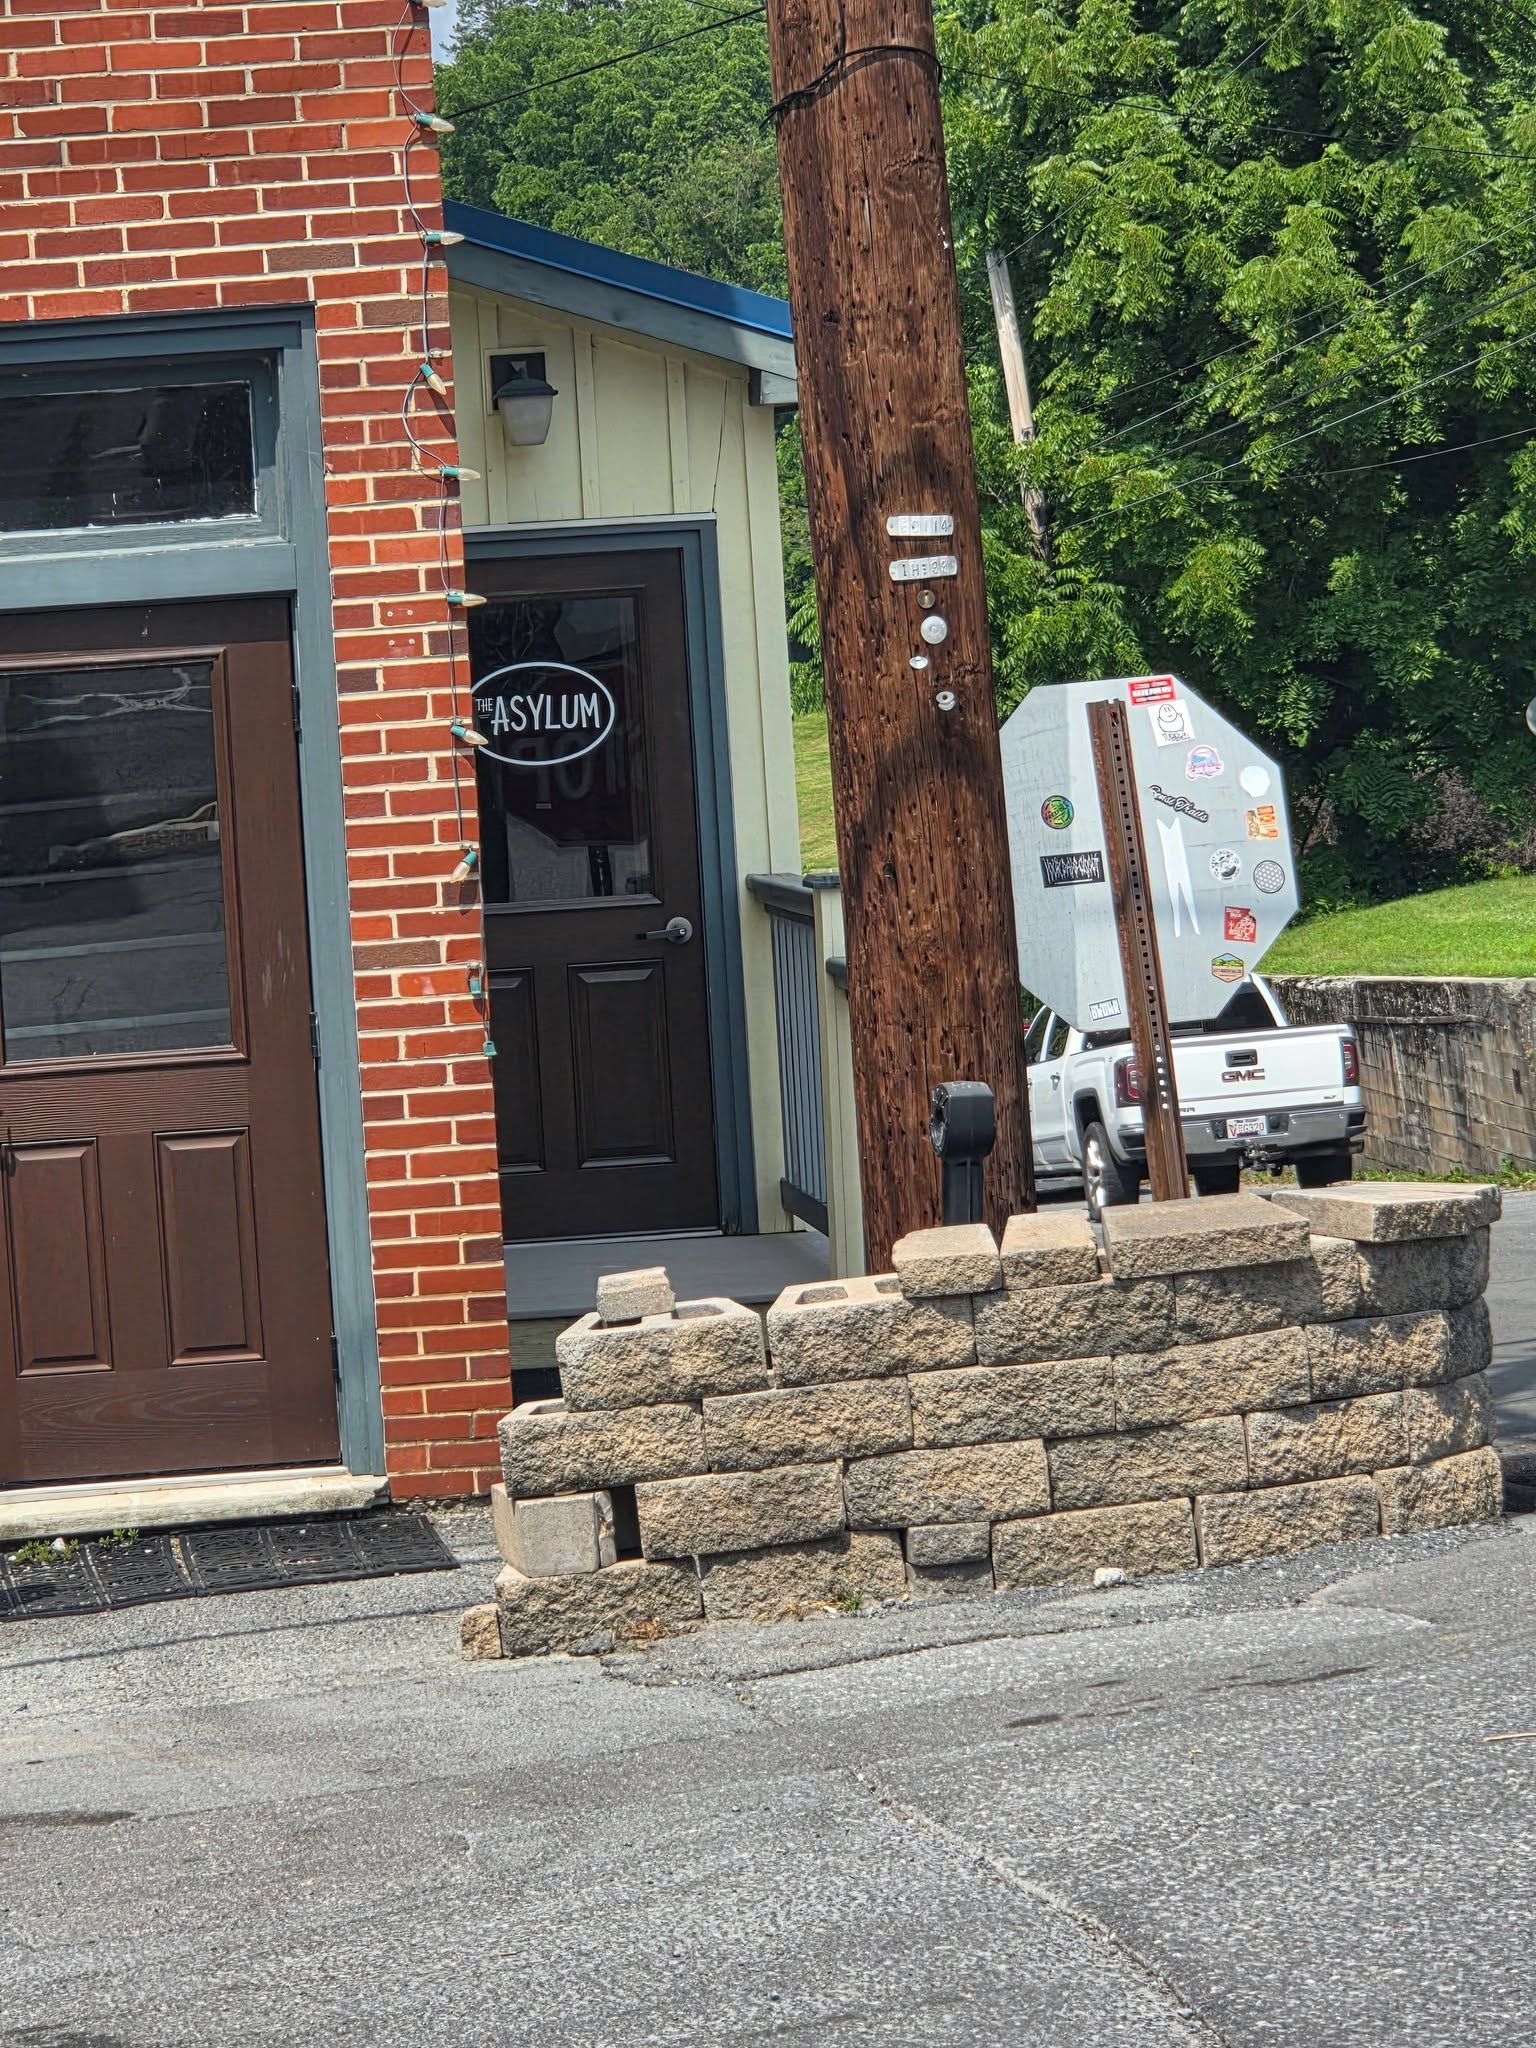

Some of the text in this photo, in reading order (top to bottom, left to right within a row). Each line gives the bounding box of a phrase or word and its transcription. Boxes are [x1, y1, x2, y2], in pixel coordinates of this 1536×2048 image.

[475, 692, 600, 736] THE ASYLUM
[1222, 1068, 1266, 1083] GMC
